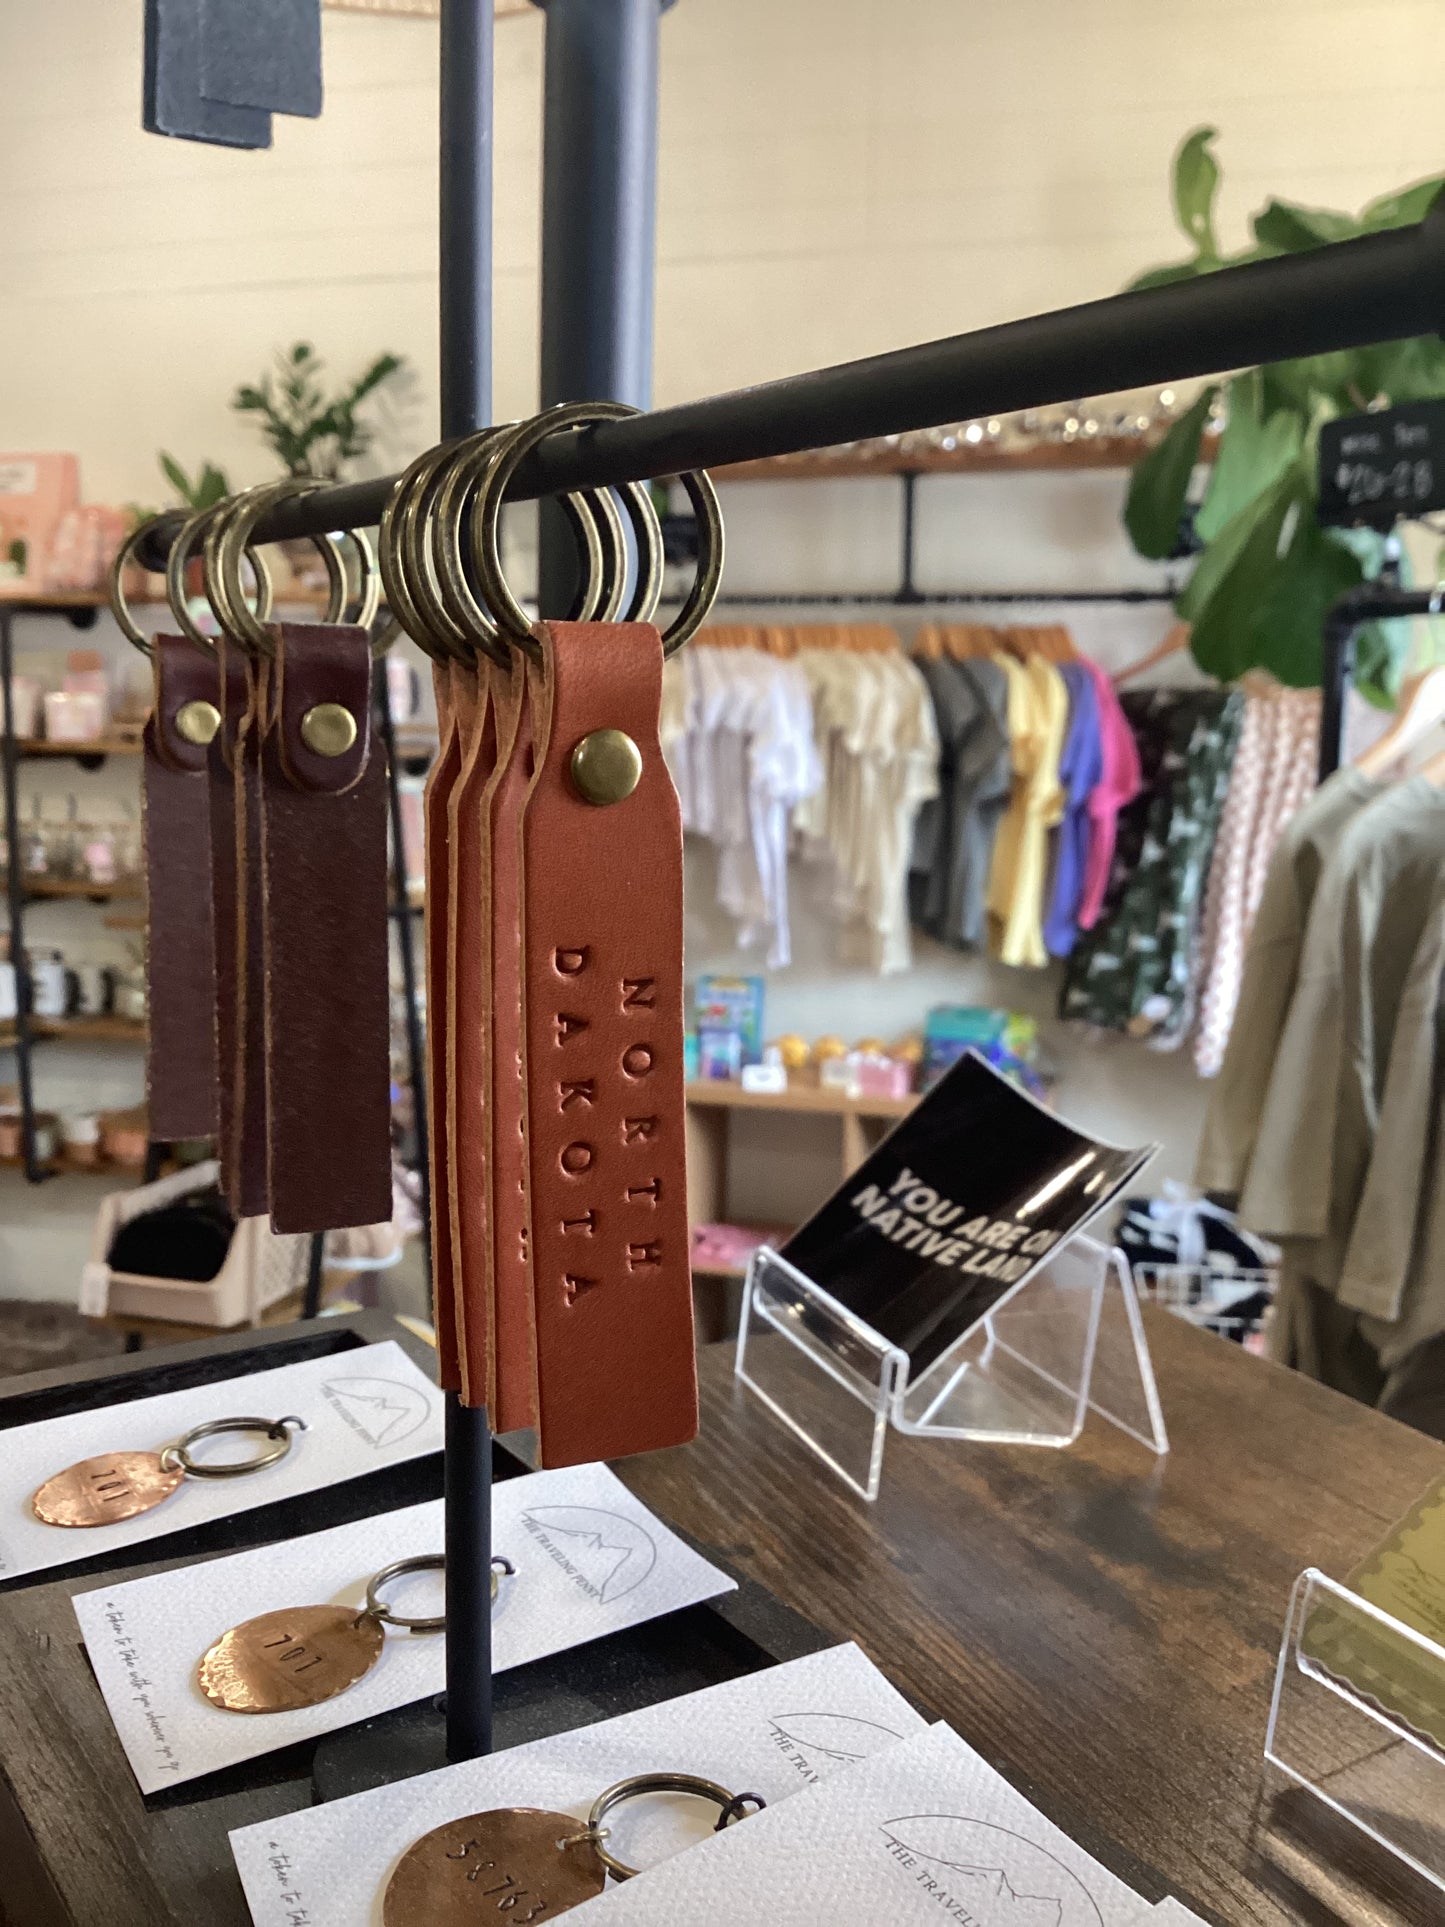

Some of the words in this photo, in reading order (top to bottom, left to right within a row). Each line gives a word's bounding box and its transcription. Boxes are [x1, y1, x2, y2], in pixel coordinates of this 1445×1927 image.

[552, 943, 598, 1308] DAKOTA
[620, 976, 662, 1273] NORTH
[850, 1183, 974, 1267] NATIVE
[888, 1166, 966, 1227] YOU
[951, 1214, 1032, 1251] ARE
[535, 1533, 578, 1575] TRAVELING
[114, 1636, 134, 1647] to
[118, 1648, 140, 1669] take
[128, 1670, 153, 1691] with
[770, 1729, 795, 1753] THE
[279, 1889, 303, 1905] to
[444, 1838, 549, 1924] 58763
[885, 1839, 918, 1871] THE
[915, 1870, 982, 1927] TRAVEL
